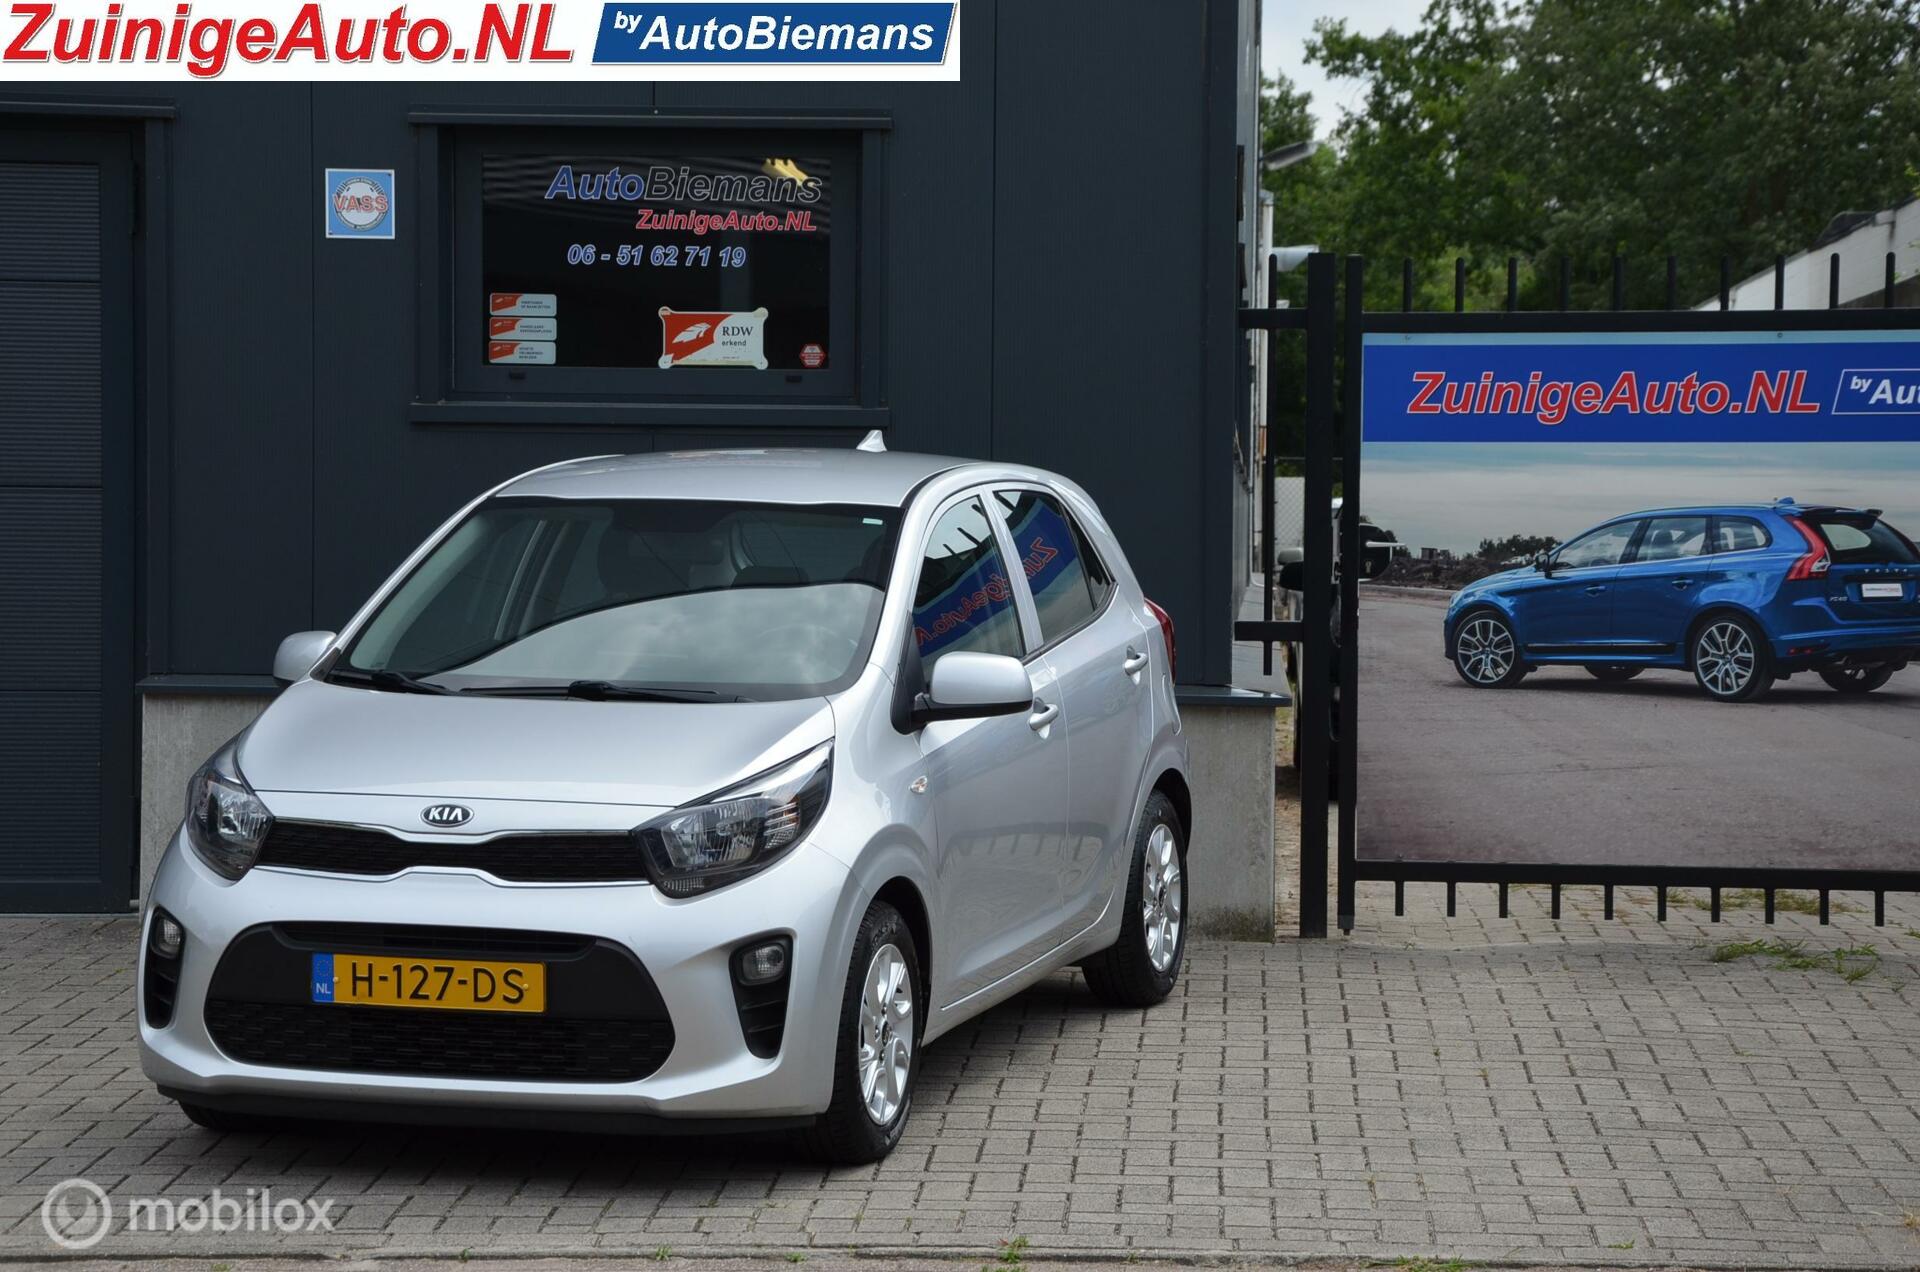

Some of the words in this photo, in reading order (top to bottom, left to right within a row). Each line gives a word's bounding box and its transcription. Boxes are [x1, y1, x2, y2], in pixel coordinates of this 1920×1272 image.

[544, 165, 823, 203] AutoBiemans
[333, 193, 389, 213] VASS
[635, 209, 818, 235] ZuinigeAuto.NL
[567, 244, 596, 265] 06
[616, 244, 644, 266] 51
[650, 245, 679, 266] 62
[684, 246, 712, 266] 71
[719, 246, 747, 267] 19
[722, 326, 753, 337] RDW
[1406, 370, 1821, 426] ZuinigeAuto.NL
[1850, 375, 1873, 393] by
[1868, 379, 1920, 404] Au
[428, 807, 463, 821] KIA
[315, 983, 331, 995] NL
[351, 962, 525, 1004] H-127-DS
